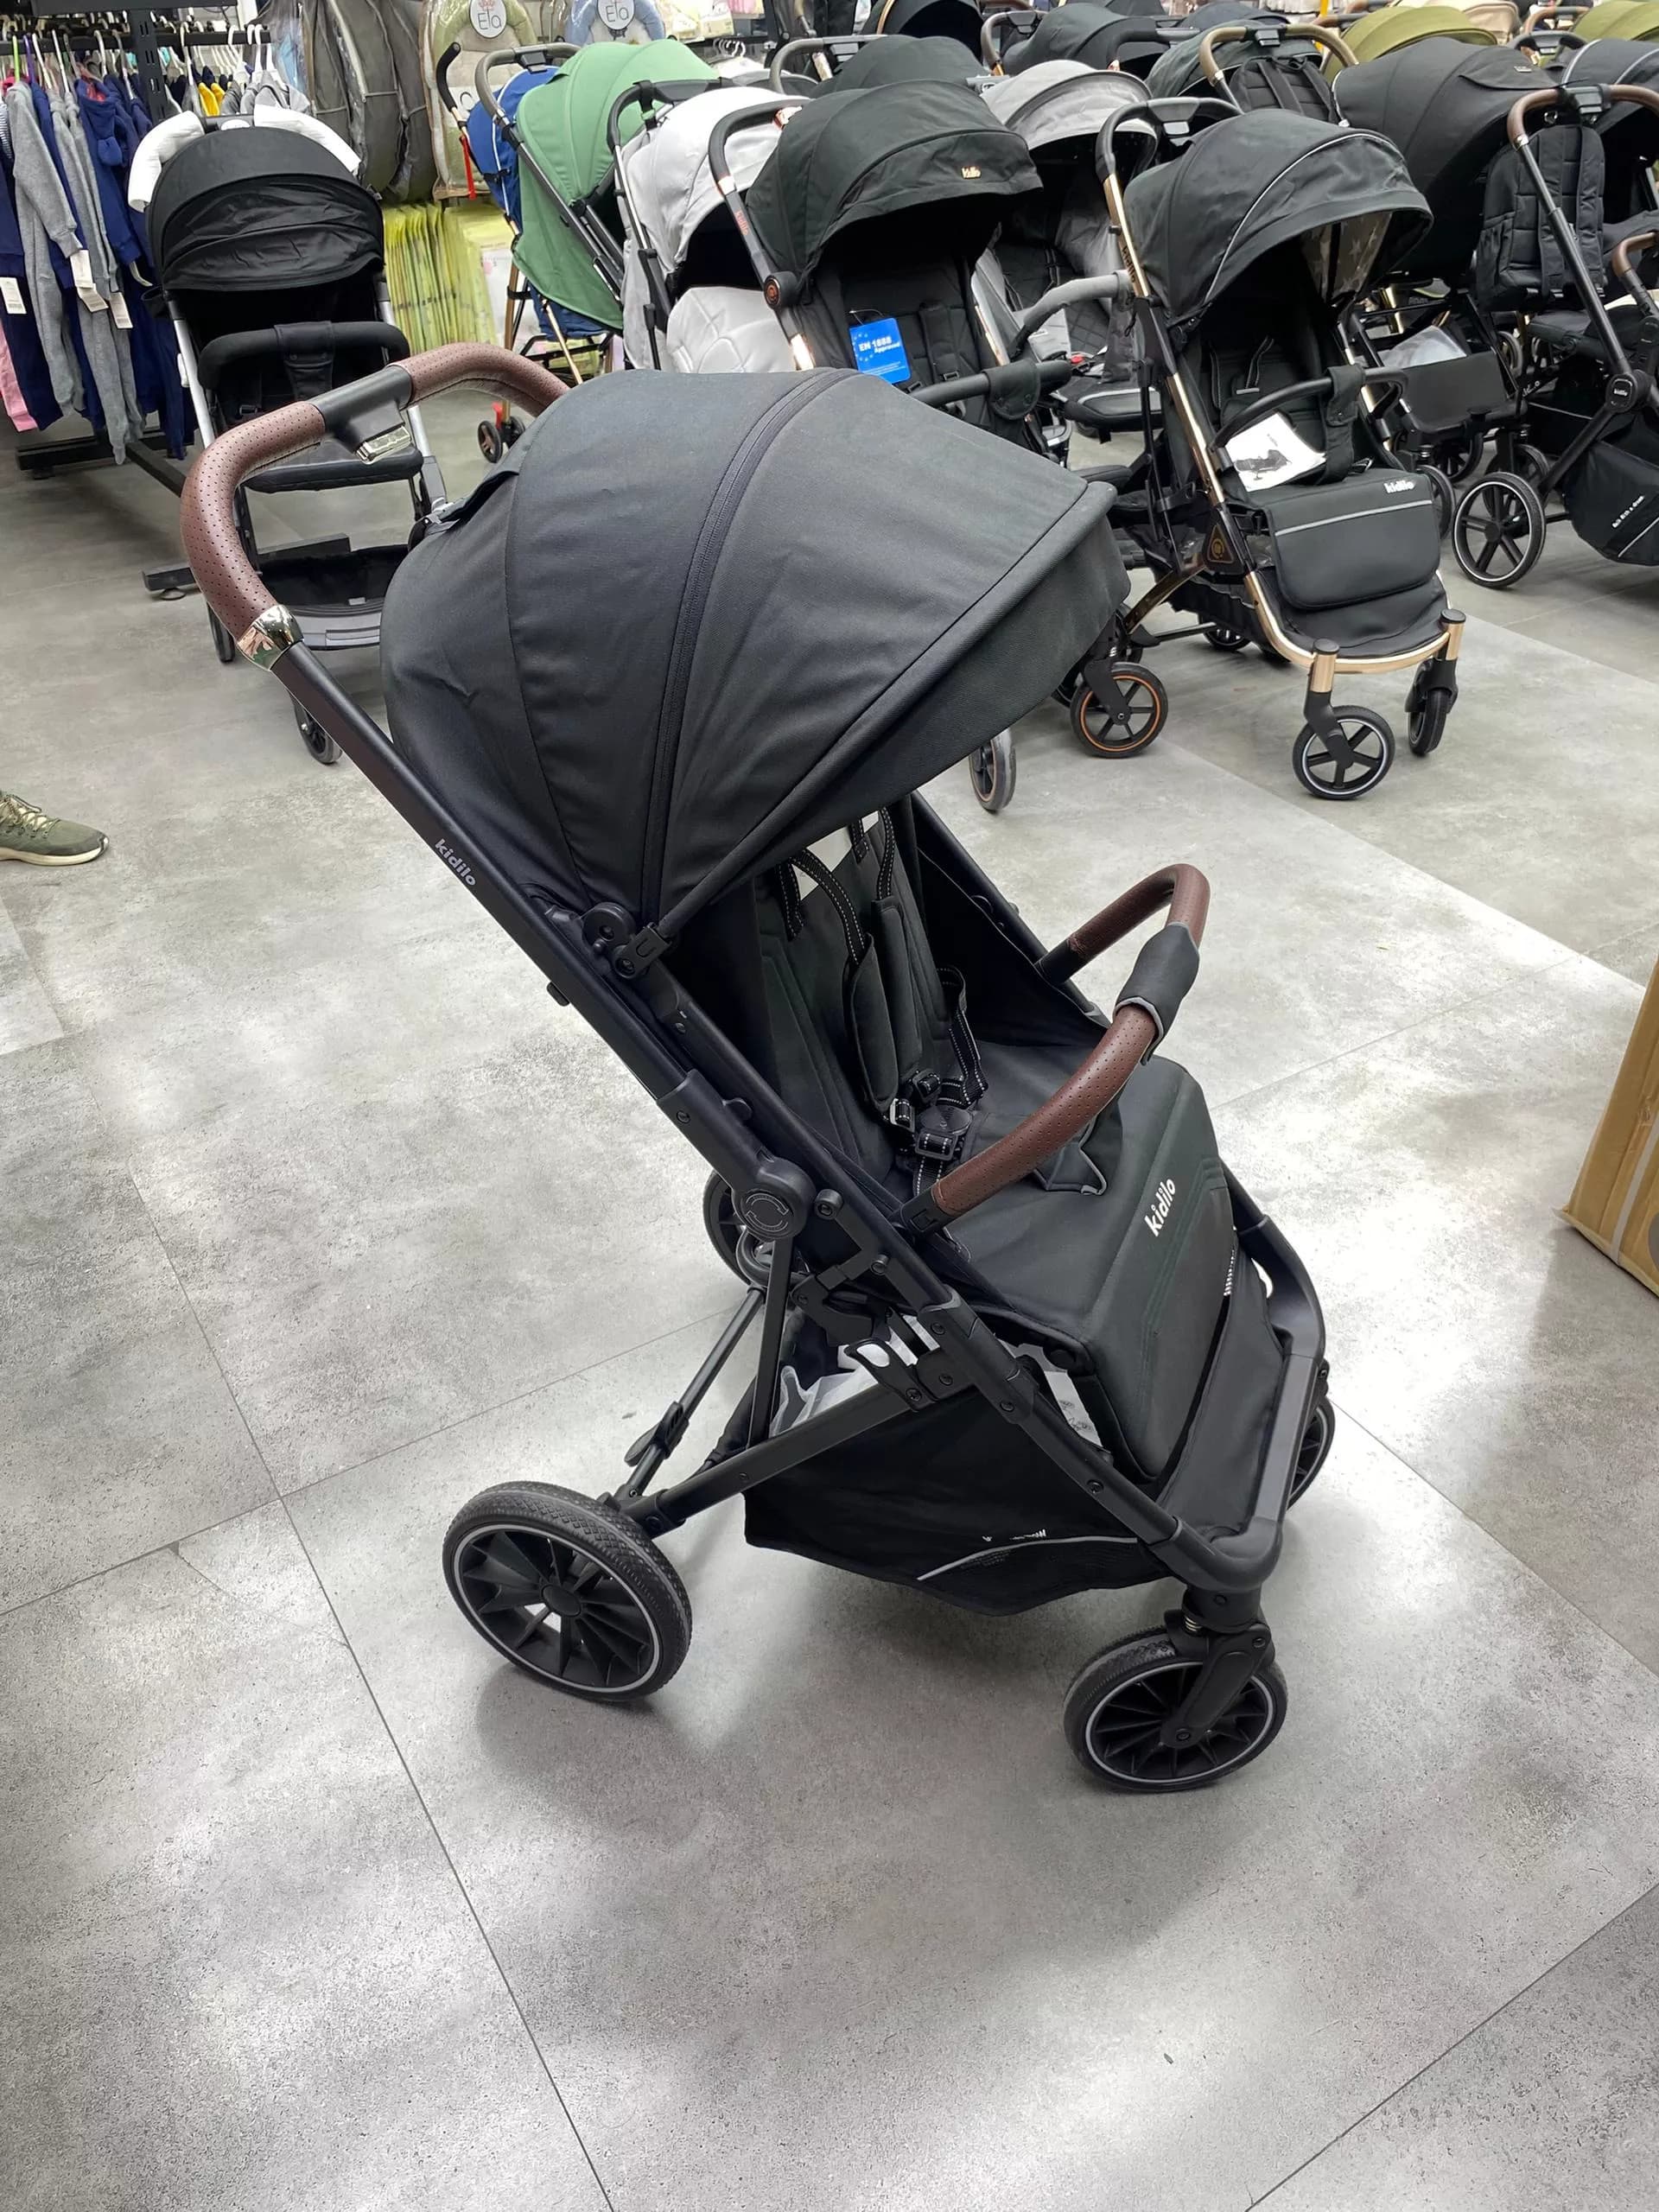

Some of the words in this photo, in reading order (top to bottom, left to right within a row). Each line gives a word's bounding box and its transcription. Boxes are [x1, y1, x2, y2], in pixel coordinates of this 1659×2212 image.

[858, 340, 872, 352] EN
[1383, 480, 1414, 493] kidilo
[435, 838, 476, 886] kidilo
[1144, 1179, 1176, 1237] kidilo
